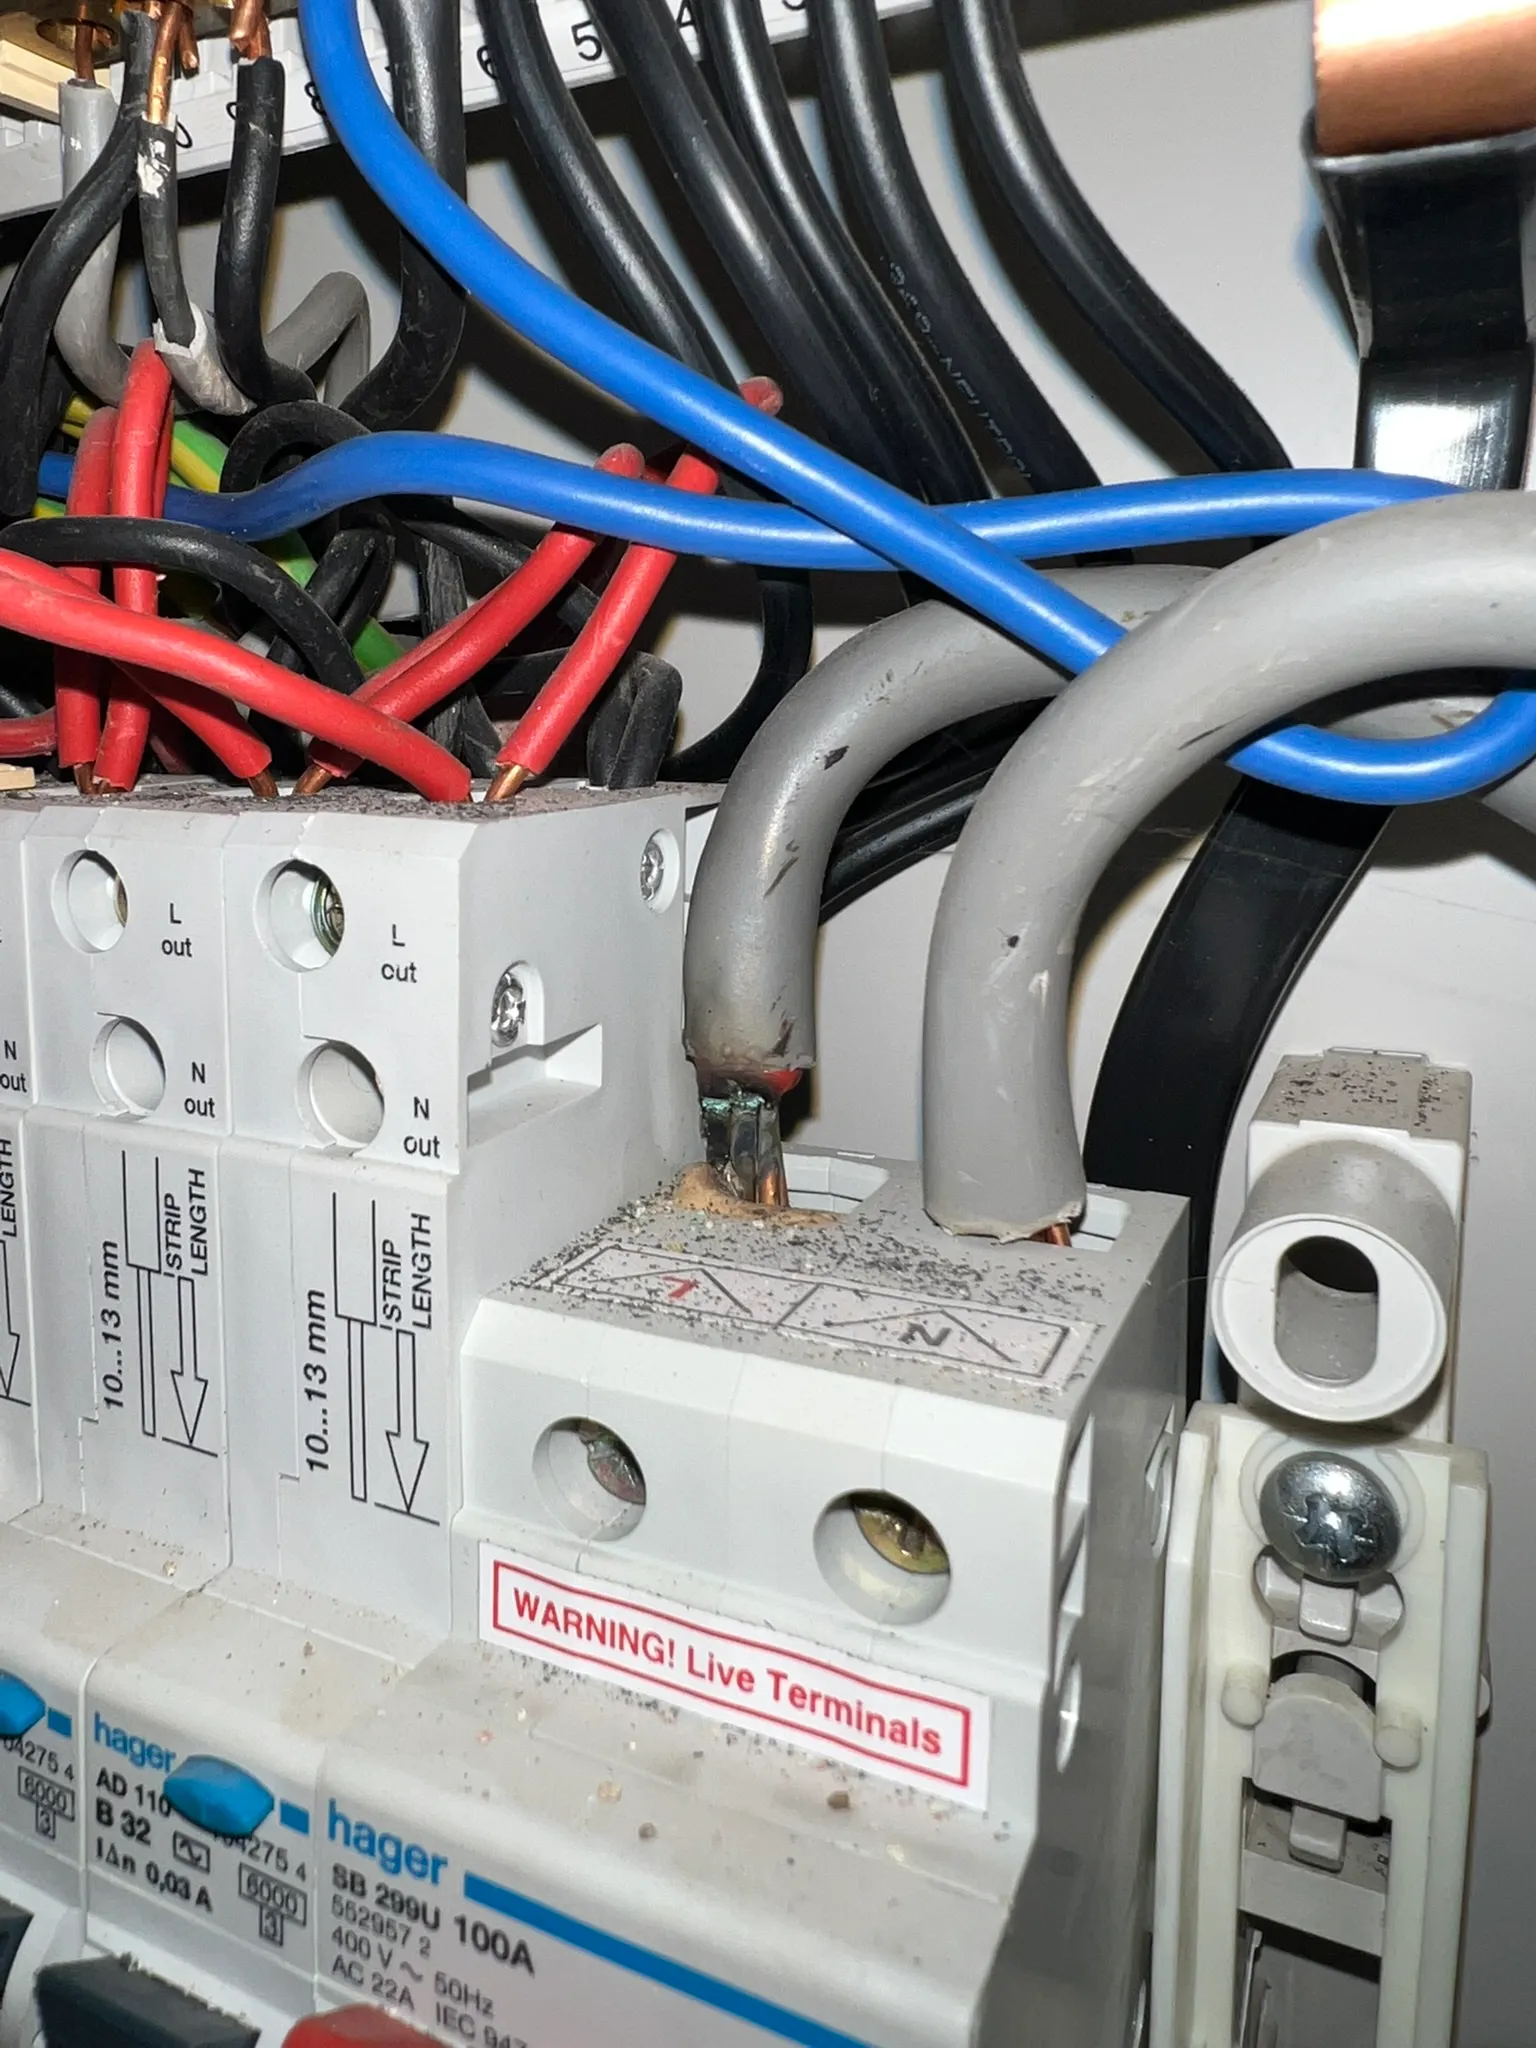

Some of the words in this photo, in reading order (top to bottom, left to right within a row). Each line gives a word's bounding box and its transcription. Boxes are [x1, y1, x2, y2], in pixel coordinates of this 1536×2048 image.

[571, 20, 604, 61] 5
[169, 903, 182, 925] L
[160, 938, 193, 959] out
[391, 924, 406, 948] L
[380, 962, 418, 984] out
[4, 1040, 17, 1061] N
[0, 1072, 27, 1093] out
[191, 1062, 206, 1084] N
[184, 1096, 216, 1119] out
[413, 1097, 430, 1120] N
[403, 1134, 440, 1159] out
[0, 1139, 17, 1237] LENGTH
[164, 1193, 184, 1270] STRIP
[188, 1168, 209, 1276] LENGTH
[102, 1240, 121, 1301] mm
[382, 1239, 403, 1323] STRIP
[411, 1213, 432, 1330] LENGTH
[306, 1289, 327, 1354] mm
[513, 1587, 675, 1669] WARNING!
[687, 1644, 757, 1694] Live
[766, 1667, 942, 1757] Terminals
[94, 1710, 177, 1773] hager
[24, 1775, 68, 1813] 6000
[64, 1763, 75, 1783] 4
[95, 1767, 127, 1797] AD
[96, 1797, 114, 1828] B
[120, 1809, 151, 1846] 32
[328, 1798, 448, 1887] hager
[145, 1861, 191, 1902] 0,03
[195, 1886, 214, 1914] A
[247, 1871, 299, 1916] 6000
[332, 1862, 368, 1899] SB
[374, 1881, 441, 1933] 299U
[453, 1914, 536, 1978] 100A
[418, 1936, 432, 1960] 2
[331, 1926, 371, 1962] 400
[377, 1943, 394, 1971] V
[434, 1970, 495, 2020] 50Hz
[331, 1954, 365, 1987] AC
[371, 1971, 415, 2013] 22A
[436, 2001, 476, 2040] IEC
